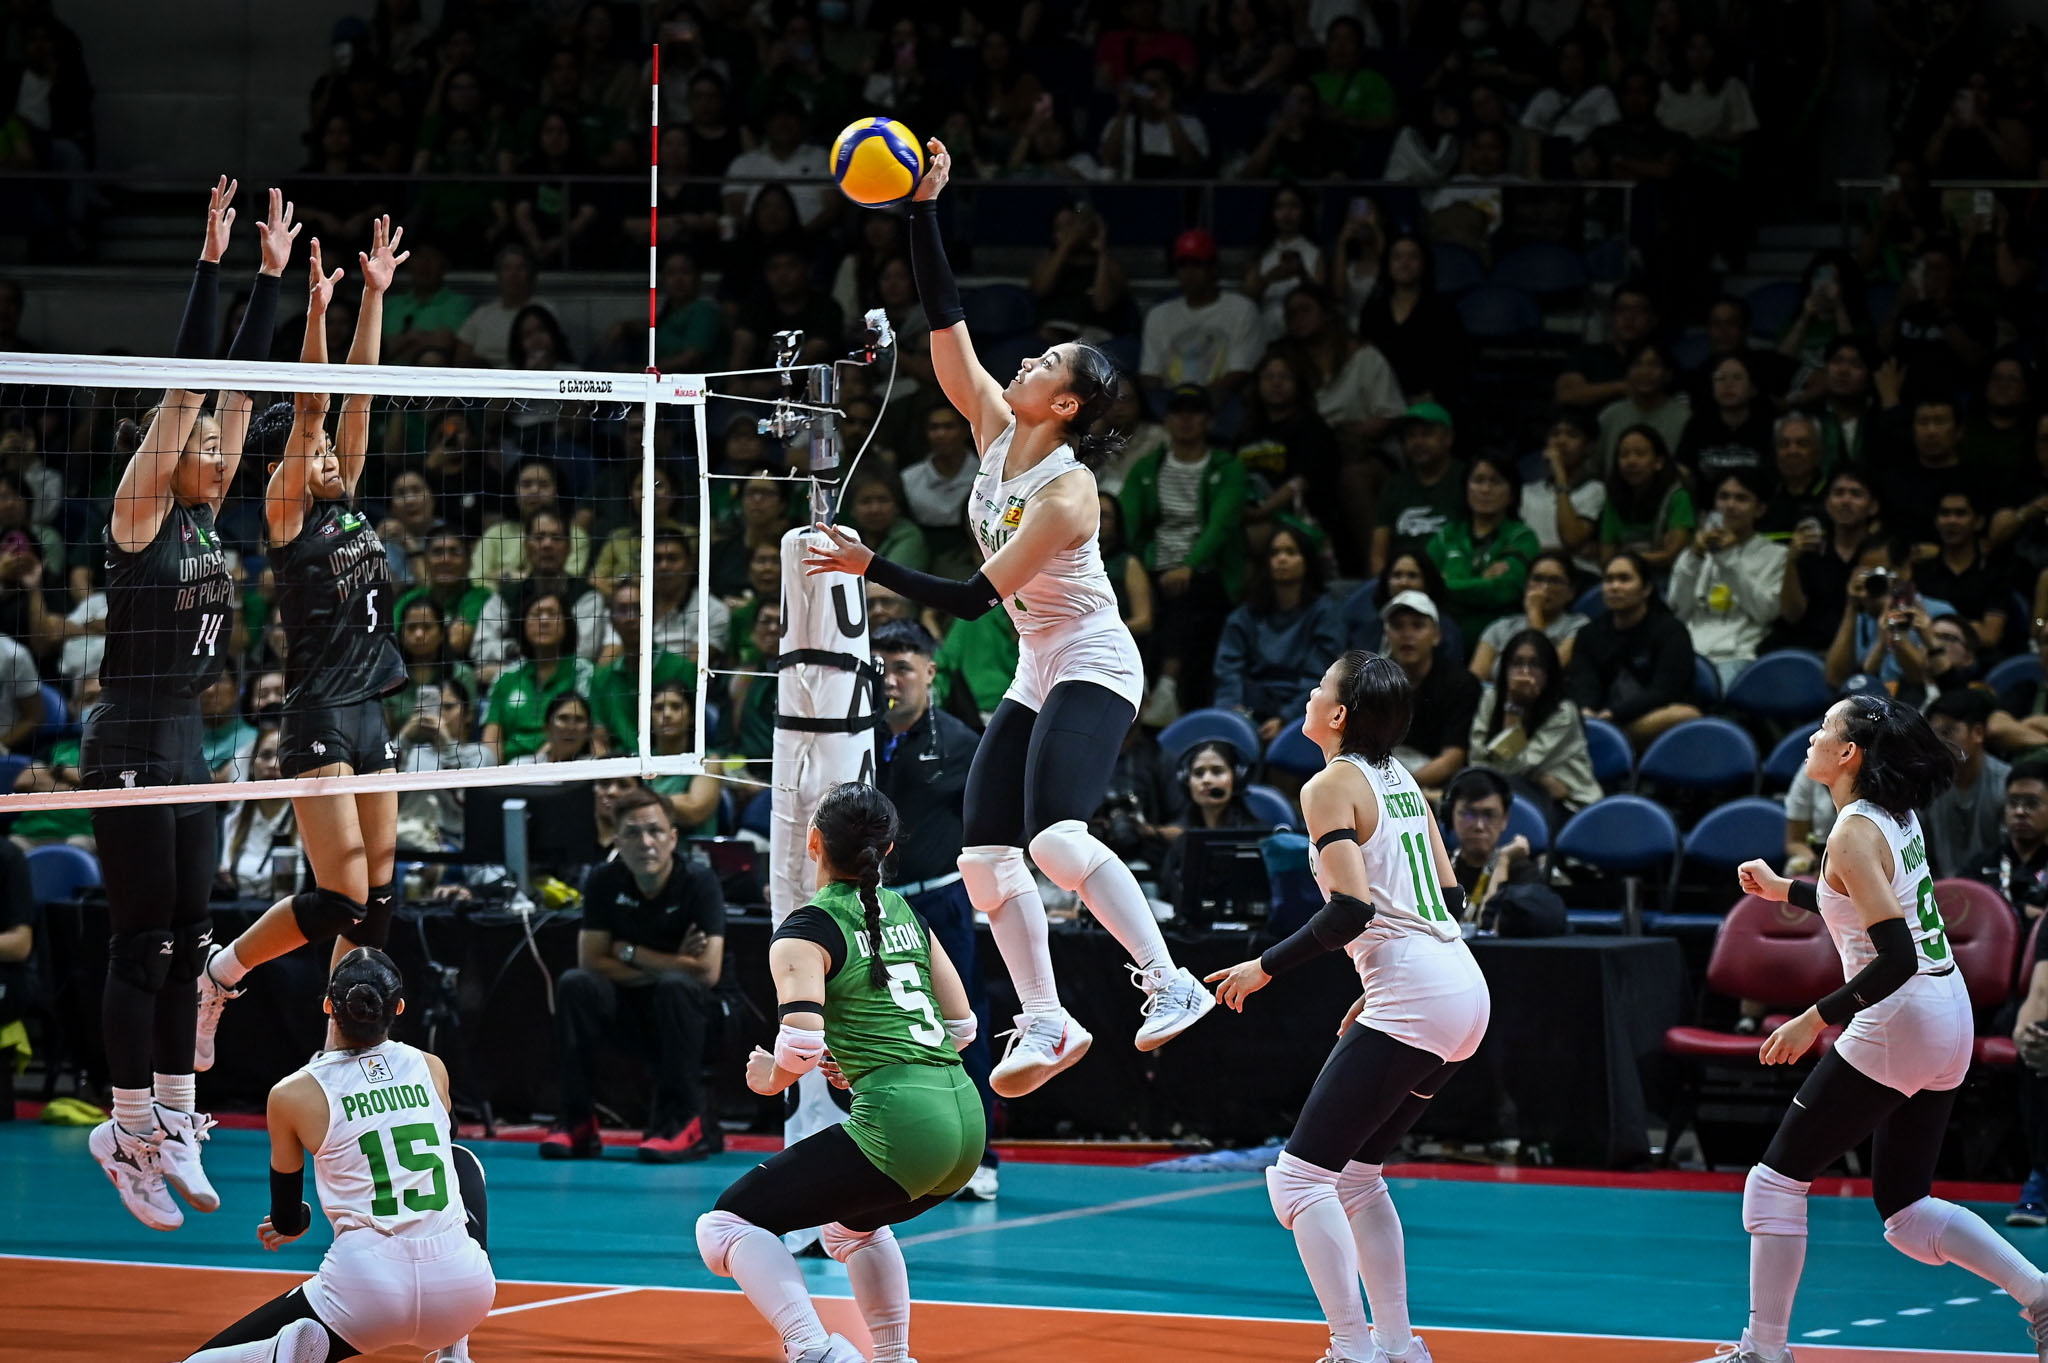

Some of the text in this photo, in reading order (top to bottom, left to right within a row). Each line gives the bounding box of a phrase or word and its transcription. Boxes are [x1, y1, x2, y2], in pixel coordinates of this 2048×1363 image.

[568, 380, 613, 393] GATORADE
[174, 585, 197, 612] NG
[366, 588, 378, 634] 5
[192, 613, 225, 657] 14
[1400, 831, 1449, 922] 11
[880, 921, 922, 954] LEON
[1916, 875, 1947, 961] 9
[885, 961, 946, 1048] 5
[341, 1083, 430, 1122] PROVIDO
[357, 1122, 449, 1217] 15
